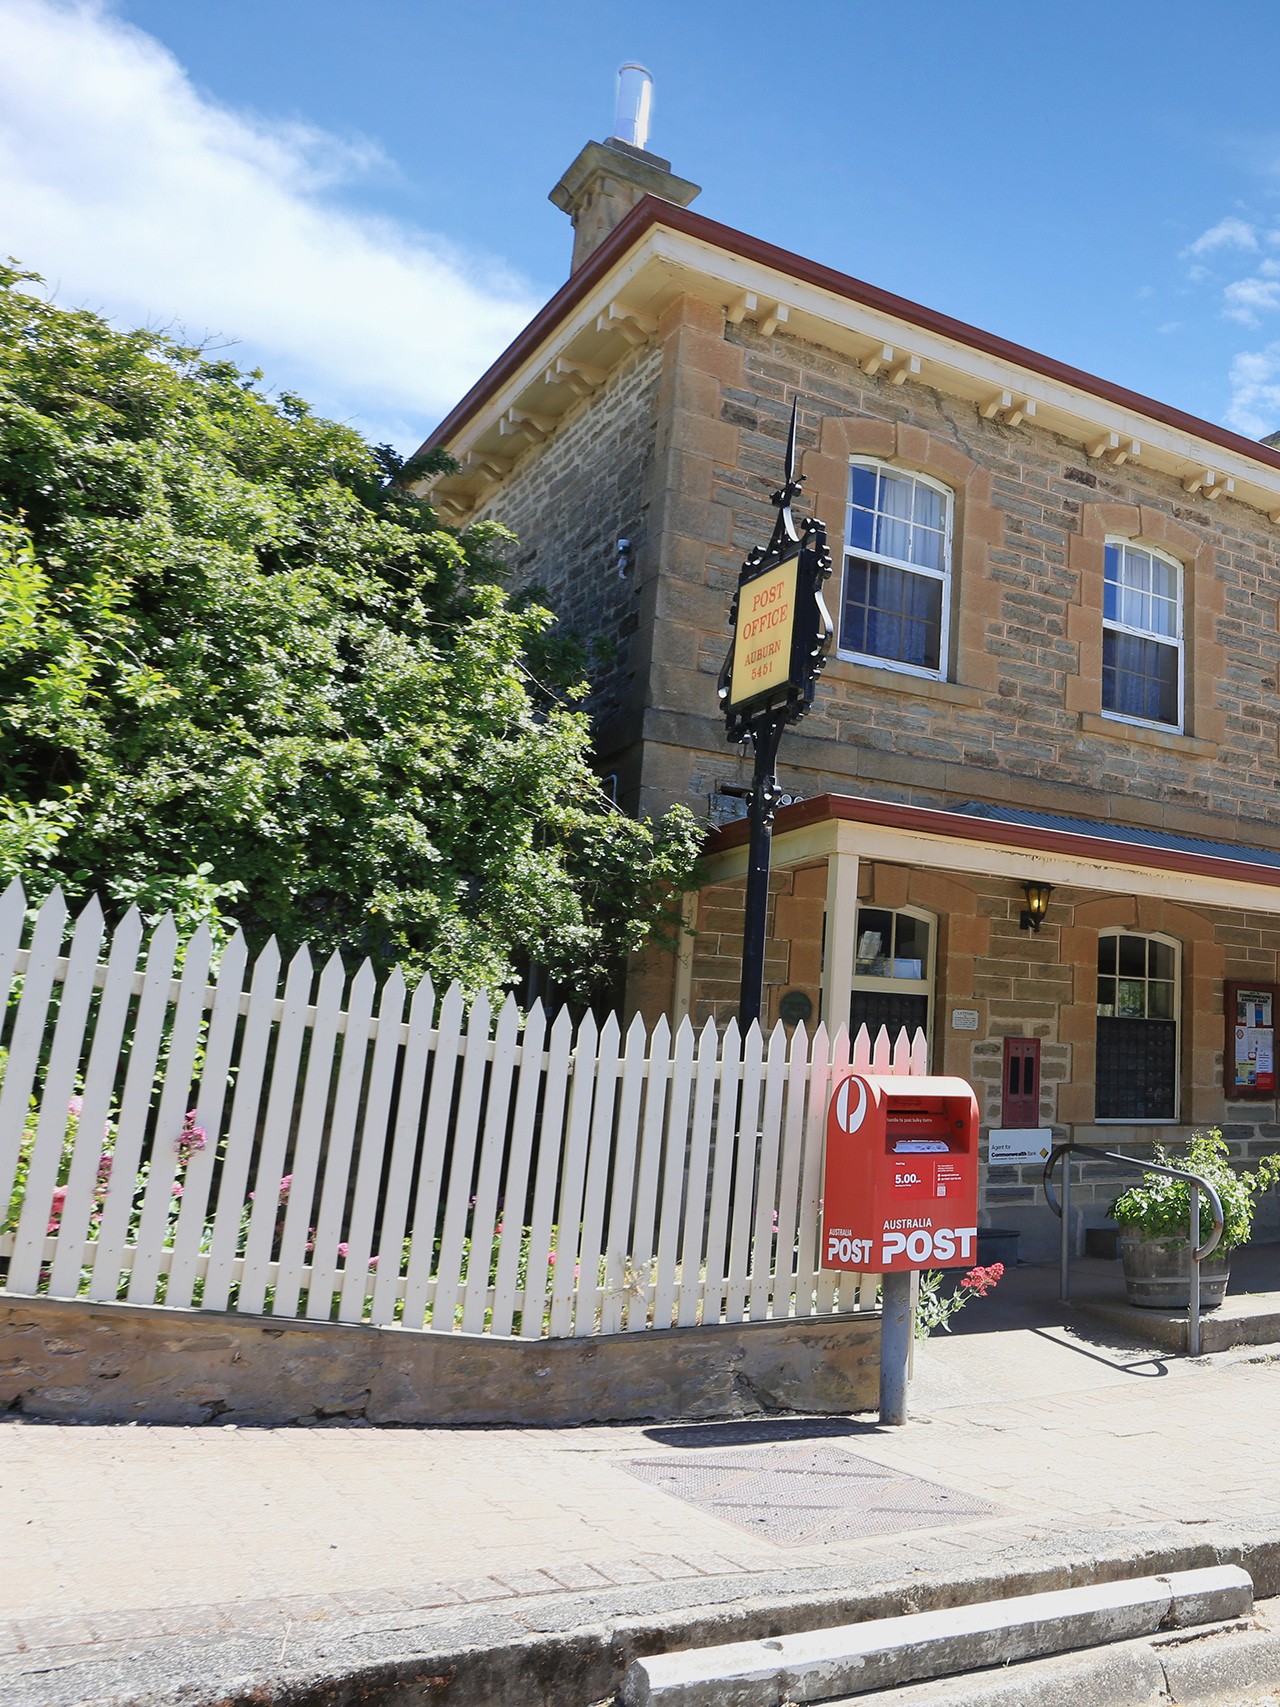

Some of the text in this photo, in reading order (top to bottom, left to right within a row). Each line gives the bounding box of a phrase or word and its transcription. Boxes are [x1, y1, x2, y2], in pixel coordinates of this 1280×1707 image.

[752, 581, 785, 612] POST
[742, 604, 788, 640] OFFICE
[744, 639, 782, 666] AUBURN
[751, 661, 773, 680] 5451
[895, 1173, 917, 1184] 5.00
[829, 1228, 852, 1237] AUSTRALIA
[883, 1218, 933, 1230] AUSTRALIA
[827, 1238, 873, 1264] POST
[882, 1227, 977, 1264] POST
